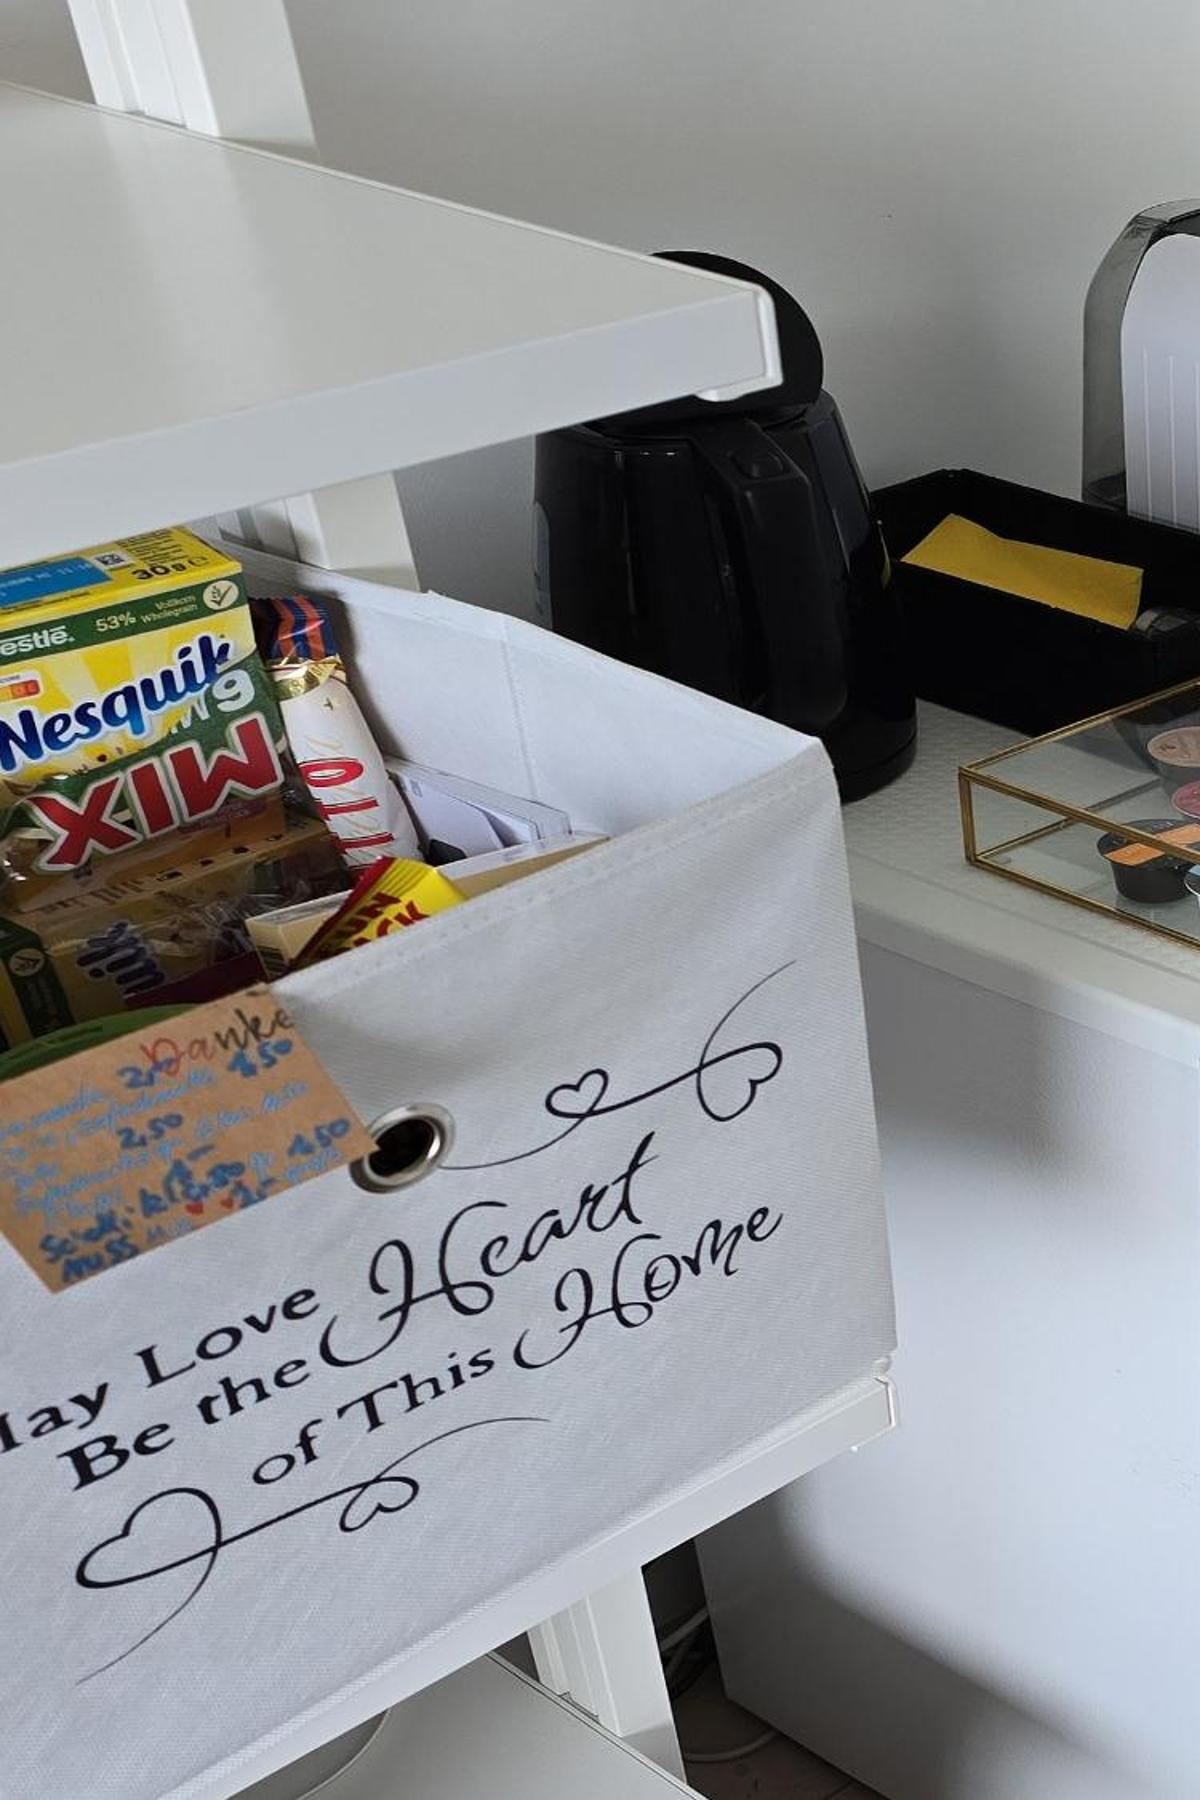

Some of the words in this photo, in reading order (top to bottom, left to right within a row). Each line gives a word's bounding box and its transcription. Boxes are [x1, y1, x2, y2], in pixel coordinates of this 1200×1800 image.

[0, 625, 68, 656] estlé
[95, 611, 137, 633] 53%
[139, 604, 199, 625] Wholegrain
[0, 635, 230, 772] Nesquik
[26, 716, 279, 867] MIX
[56, 1423, 175, 1492] Be
[197, 1358, 311, 1425] the
[319, 1131, 659, 1367] Heart
[136, 1289, 320, 1388] Love
[252, 1419, 323, 1485] of
[336, 1349, 496, 1433] This
[513, 1207, 784, 1369] Home
